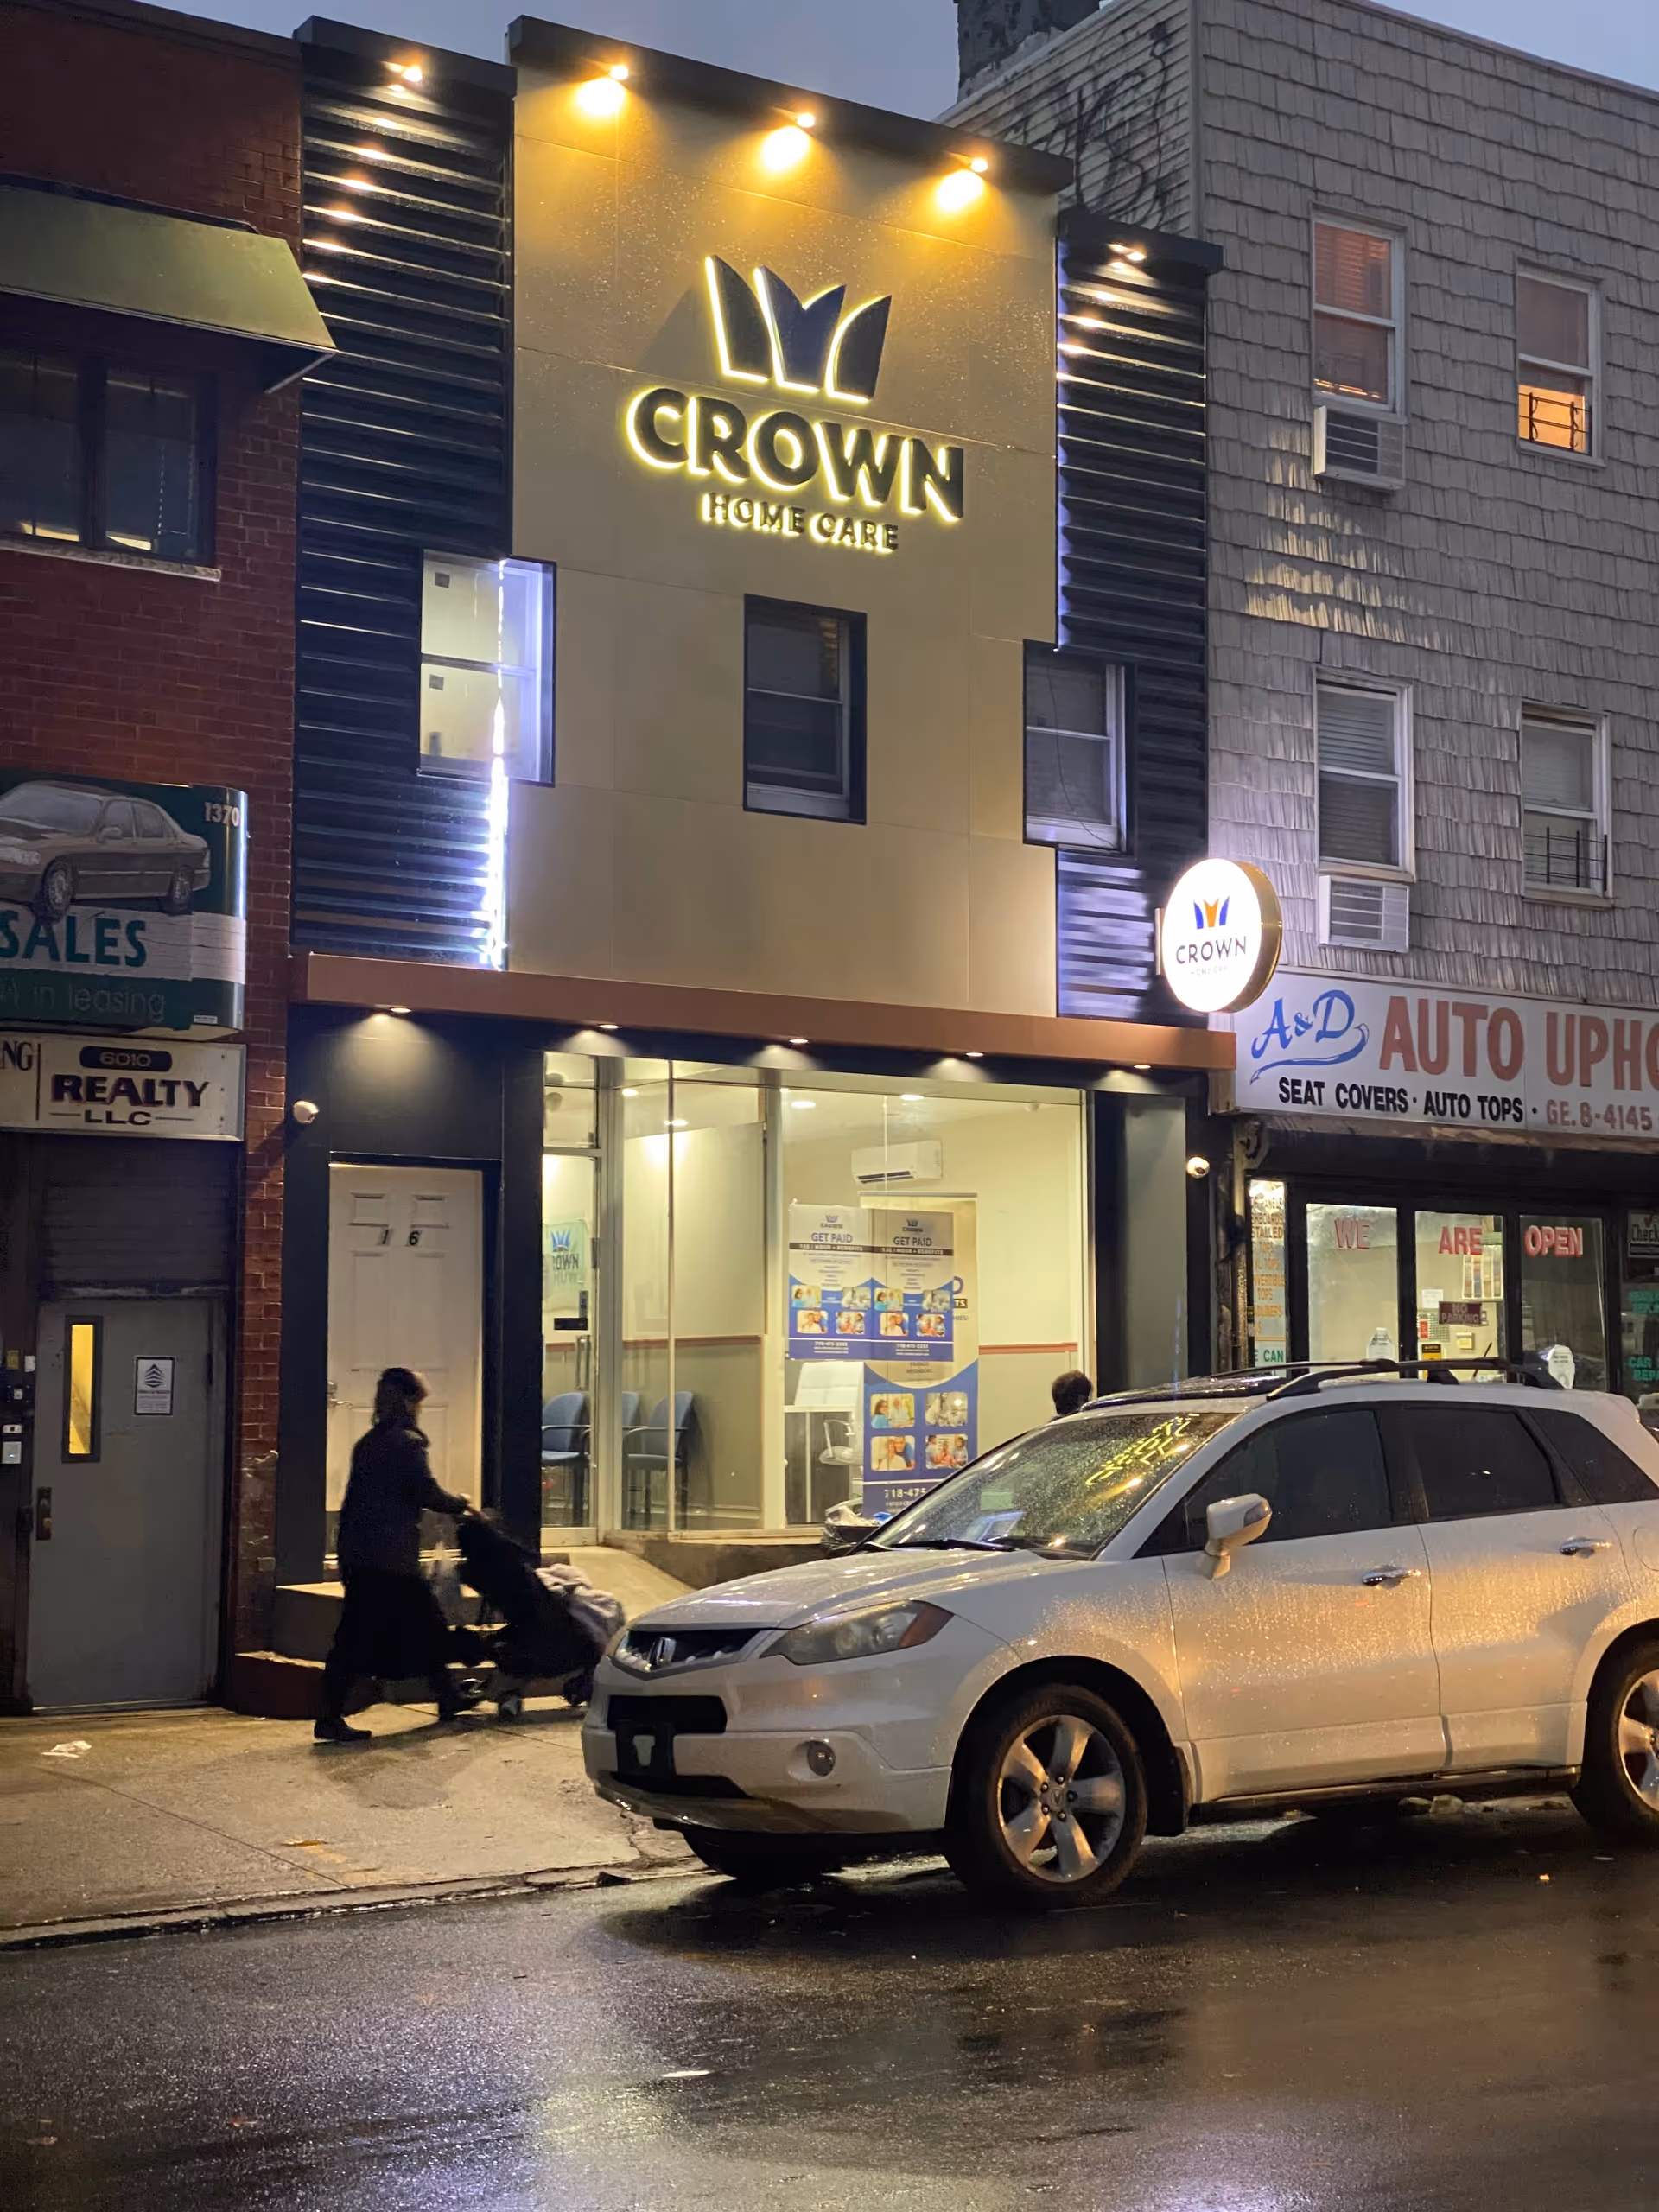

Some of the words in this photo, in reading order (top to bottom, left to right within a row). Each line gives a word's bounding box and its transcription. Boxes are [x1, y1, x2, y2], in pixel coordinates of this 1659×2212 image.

[628, 387, 965, 522] CROWN
[702, 491, 807, 537] HOME
[810, 511, 900, 554] CARE
[204, 801, 241, 828] 1370
[0, 909, 147, 968] SALES
[1175, 935, 1247, 965] CROWN
[68, 982, 167, 1023] leasing
[1250, 989, 1358, 1061] A&D
[1379, 995, 1525, 1082] AUTO
[99, 1052, 153, 1067] 6010
[51, 1073, 212, 1109] REALTY
[1279, 1077, 1325, 1107] SEAT
[1335, 1082, 1409, 1114] COVERS
[1424, 1090, 1471, 1122] AUTO
[1478, 1095, 1524, 1123] TOPS
[84, 1109, 153, 1127] LLC
[408, 1230, 422, 1246] 6
[810, 1232, 830, 1243] GET
[831, 1233, 853, 1244] PAID
[893, 1236, 911, 1246] GET
[912, 1236, 932, 1247] PAID
[1335, 1218, 1370, 1249] WE
[1438, 1225, 1484, 1255] ARE
[1523, 1224, 1584, 1258] OPEN
[1441, 1313, 1480, 1325] PARKING
[1452, 1302, 1469, 1314] NO
[1263, 1349, 1284, 1363] CAN
